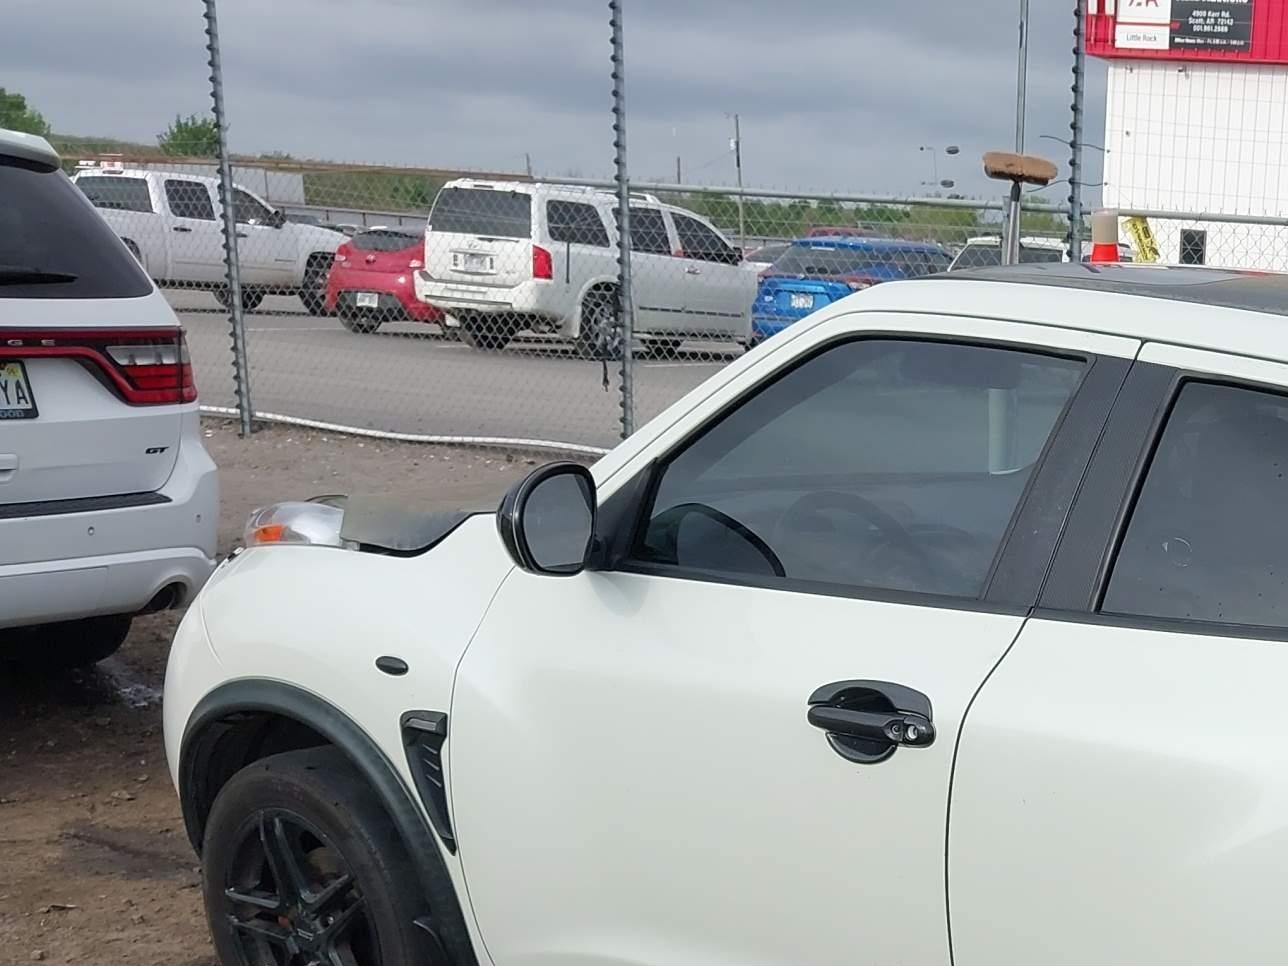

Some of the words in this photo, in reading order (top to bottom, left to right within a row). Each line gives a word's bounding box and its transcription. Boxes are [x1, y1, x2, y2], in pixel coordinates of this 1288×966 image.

[1126, 33, 1142, 42] Little
[1143, 34, 1157, 42] Rock
[145, 446, 170, 455] GT
